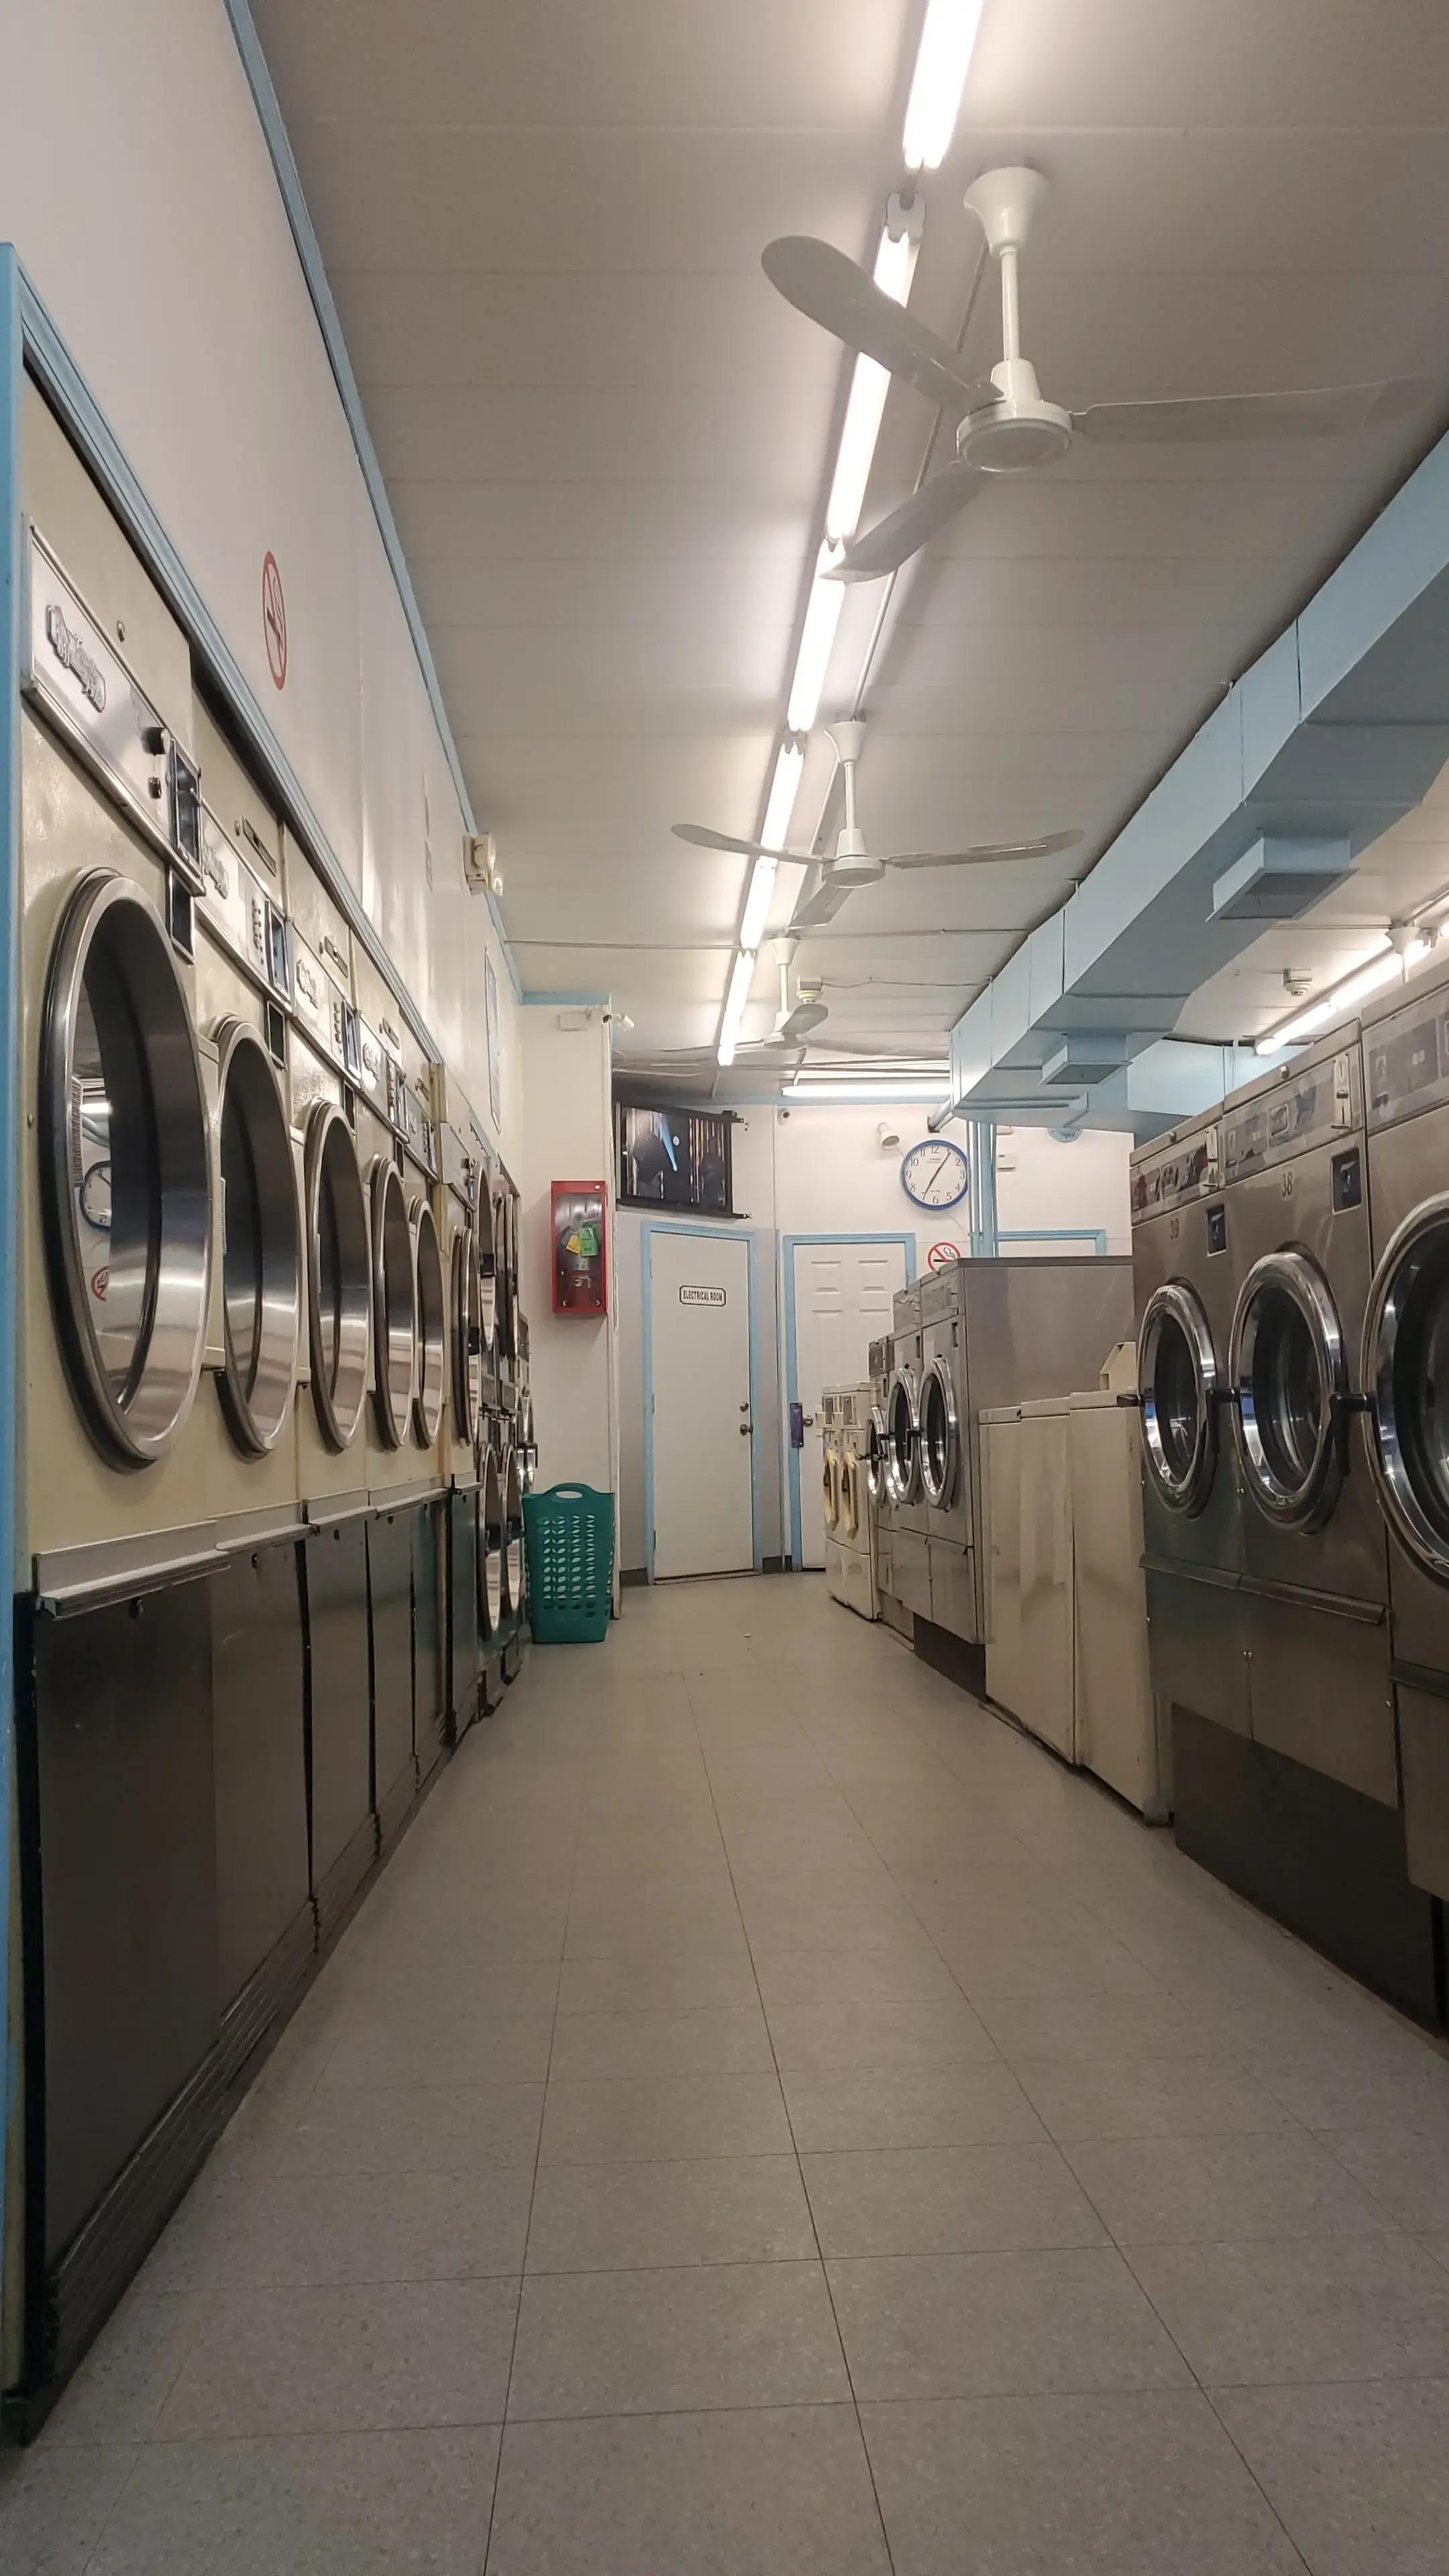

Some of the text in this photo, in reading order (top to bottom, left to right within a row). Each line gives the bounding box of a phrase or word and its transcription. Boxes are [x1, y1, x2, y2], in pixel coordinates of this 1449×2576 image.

[920, 1148, 925, 1157] 11
[931, 1146, 939, 1154] 12
[910, 1158, 919, 1167] 10
[955, 1158, 962, 1167] 2
[906, 1171, 912, 1179] 9
[959, 1171, 965, 1179] 3
[910, 1183, 916, 1191] 8
[955, 1183, 960, 1191] 4
[1282, 1171, 1292, 1197] 38
[921, 1192, 926, 1201] 7
[932, 1196, 938, 1204] 6
[946, 1192, 952, 1201] 5
[1170, 1218, 1179, 1240] 39
[684, 1290, 722, 1301] ELECTRICAL ROOM
